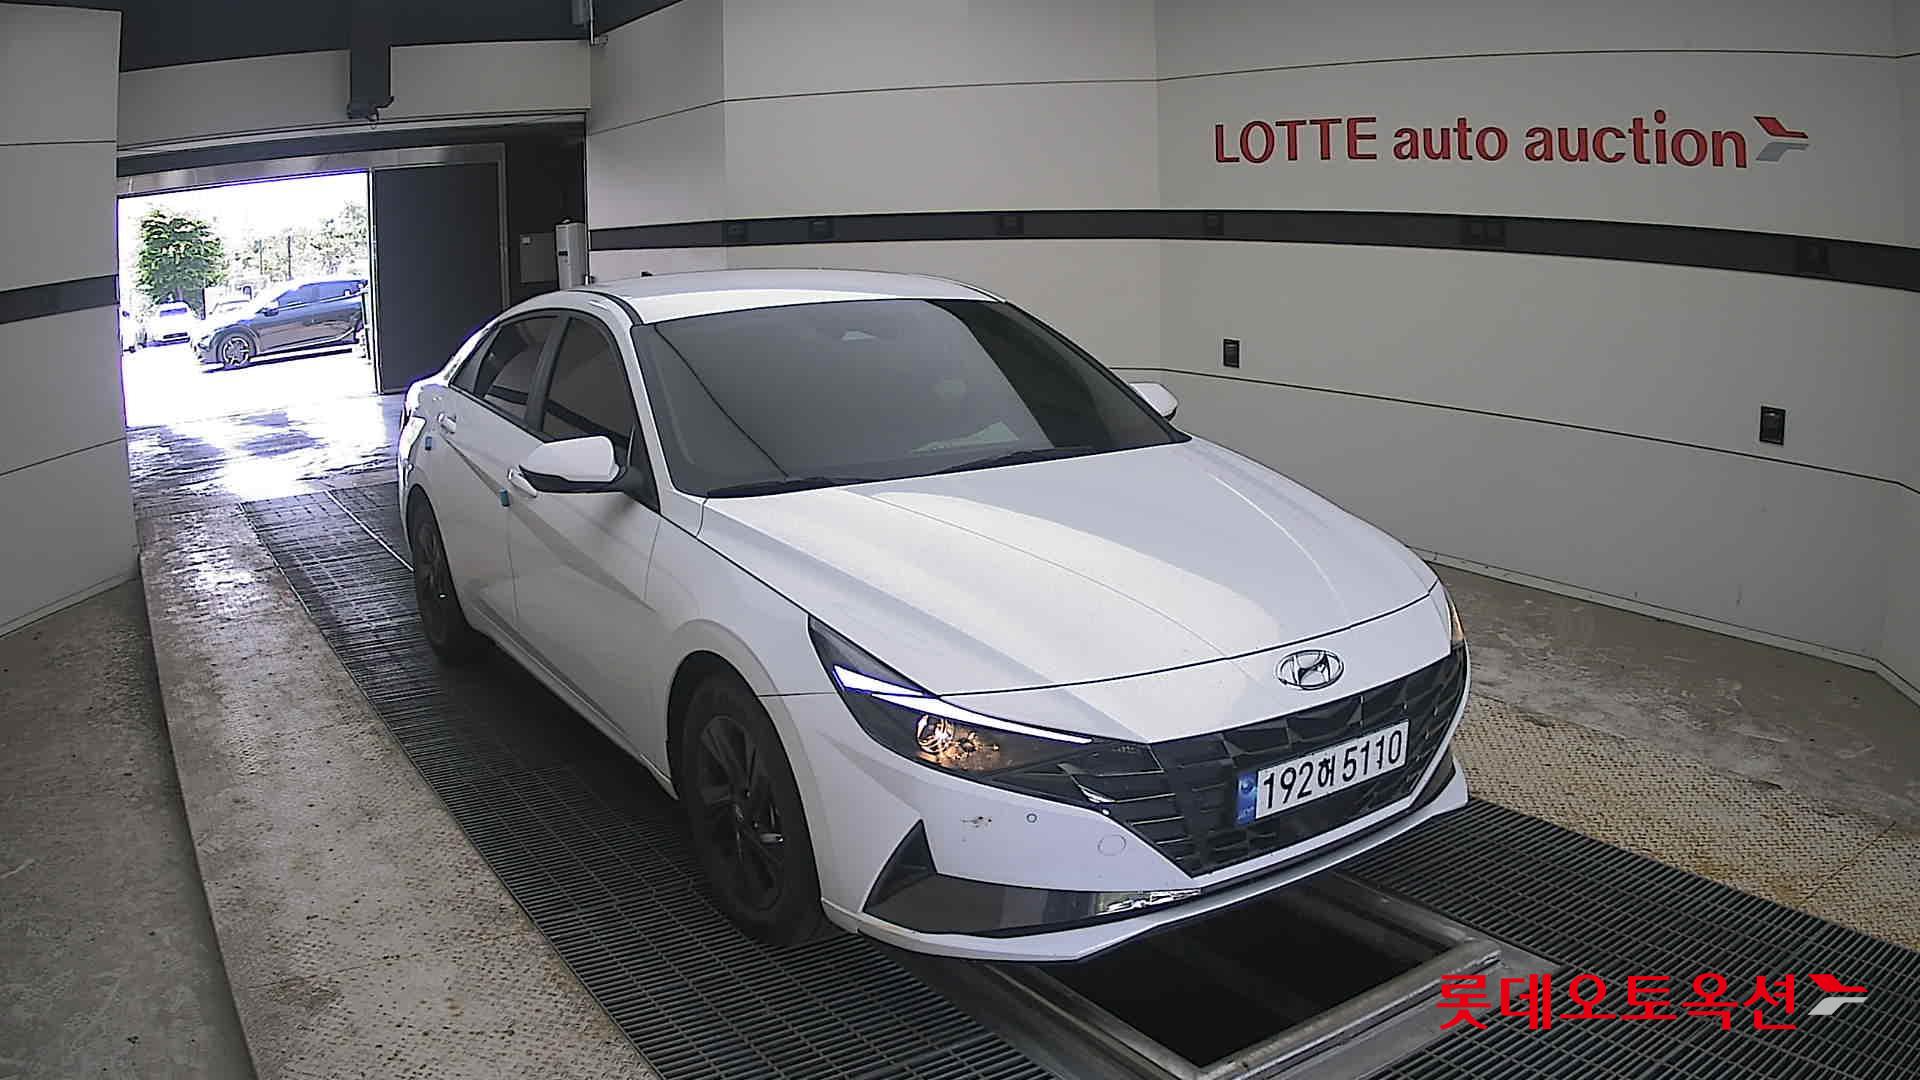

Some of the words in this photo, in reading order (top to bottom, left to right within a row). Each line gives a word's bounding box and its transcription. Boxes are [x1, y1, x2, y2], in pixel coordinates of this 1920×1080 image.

[1214, 116, 1377, 163] LOTTE
[1392, 117, 1509, 162] auto
[1524, 109, 1748, 169] auction
[1342, 730, 1402, 782] 5110
